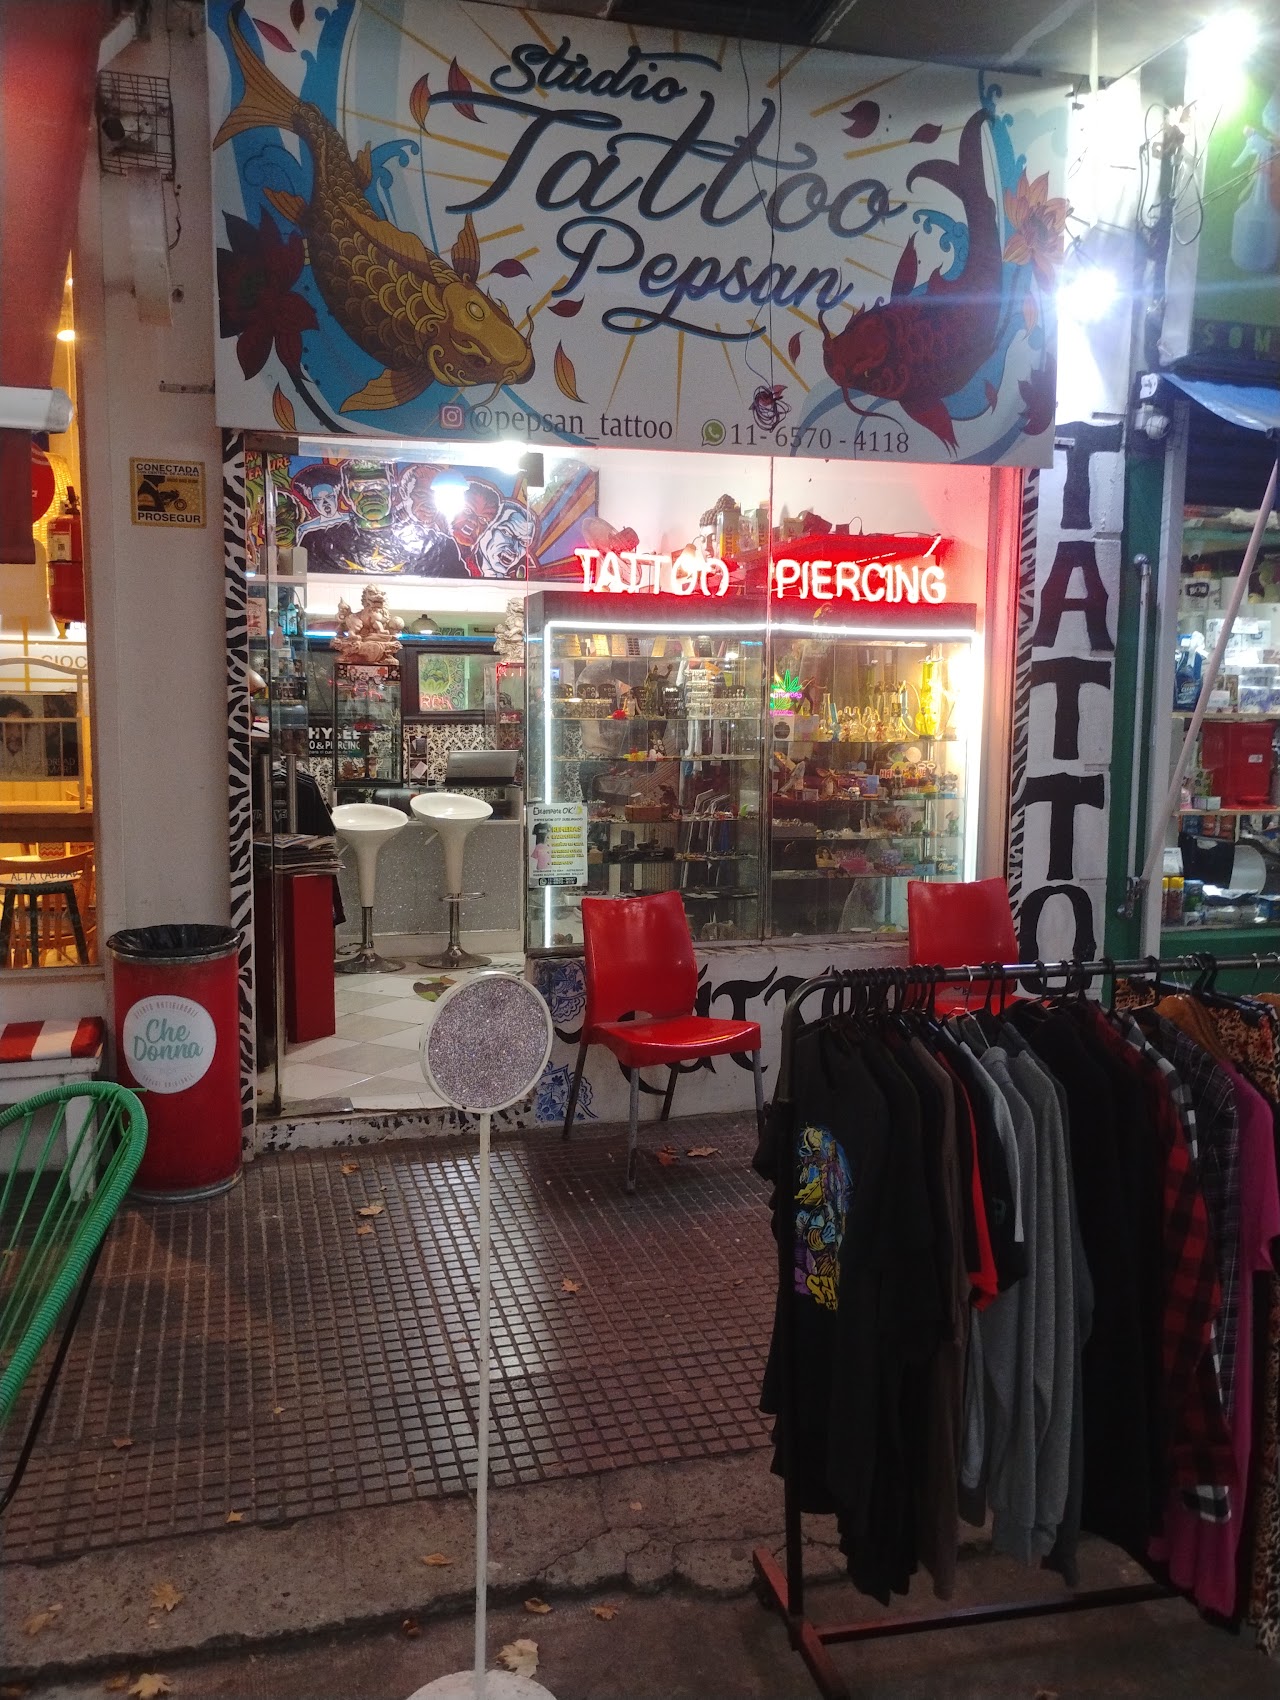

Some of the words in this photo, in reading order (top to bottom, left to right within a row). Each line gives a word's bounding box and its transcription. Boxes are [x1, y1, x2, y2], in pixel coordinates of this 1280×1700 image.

[490, 36, 722, 102] Studio
[428, 90, 907, 239] Tattoo
[551, 215, 854, 340] Pepsan
[470, 405, 673, 441] @pepsan_tattoo
[775, 425, 831, 450] 6570
[854, 430, 909, 454] 4118
[136, 463, 199, 475] CONECTADA
[138, 512, 201, 523] PROSEGUR
[574, 548, 730, 597] TATTOO
[775, 558, 947, 604] PIERCING
[133, 1035, 204, 1061] Donna
[145, 1018, 191, 1044] Che
